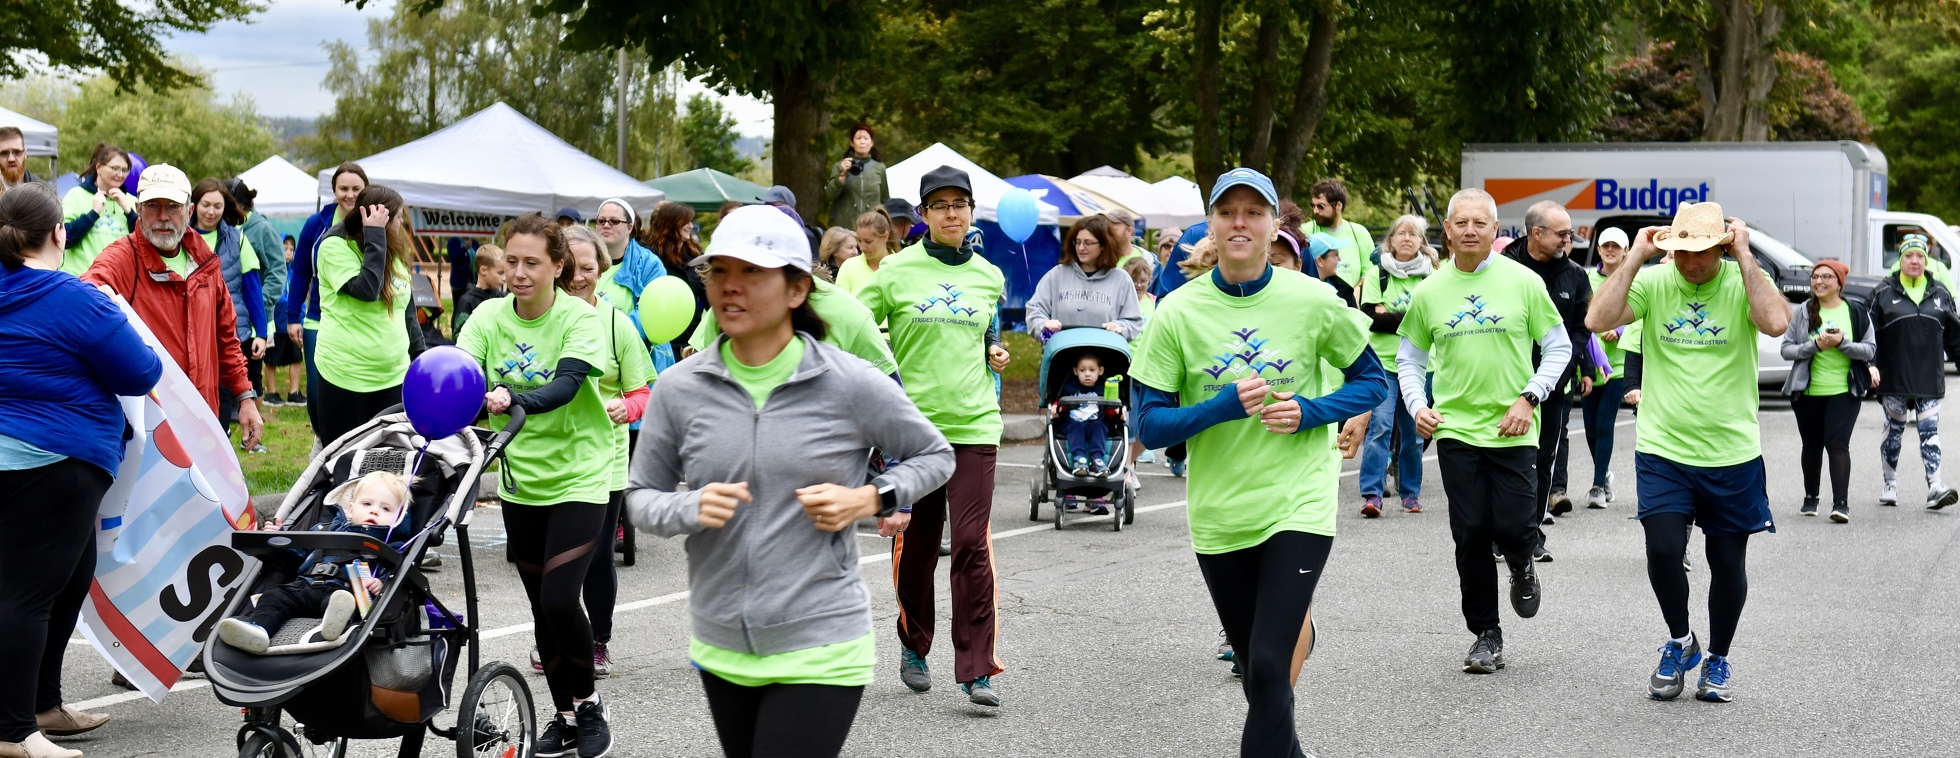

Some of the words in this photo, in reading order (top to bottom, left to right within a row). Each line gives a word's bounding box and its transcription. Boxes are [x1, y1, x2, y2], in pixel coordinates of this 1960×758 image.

[1595, 178, 1710, 216] Budget
[422, 211, 500, 227] Welcome
[1059, 289, 1111, 306] WASHINGTON
[946, 318, 980, 328] CHILDSTRIVE
[1444, 331, 1464, 340] STRIDES
[1660, 336, 1680, 344] STRIDES
